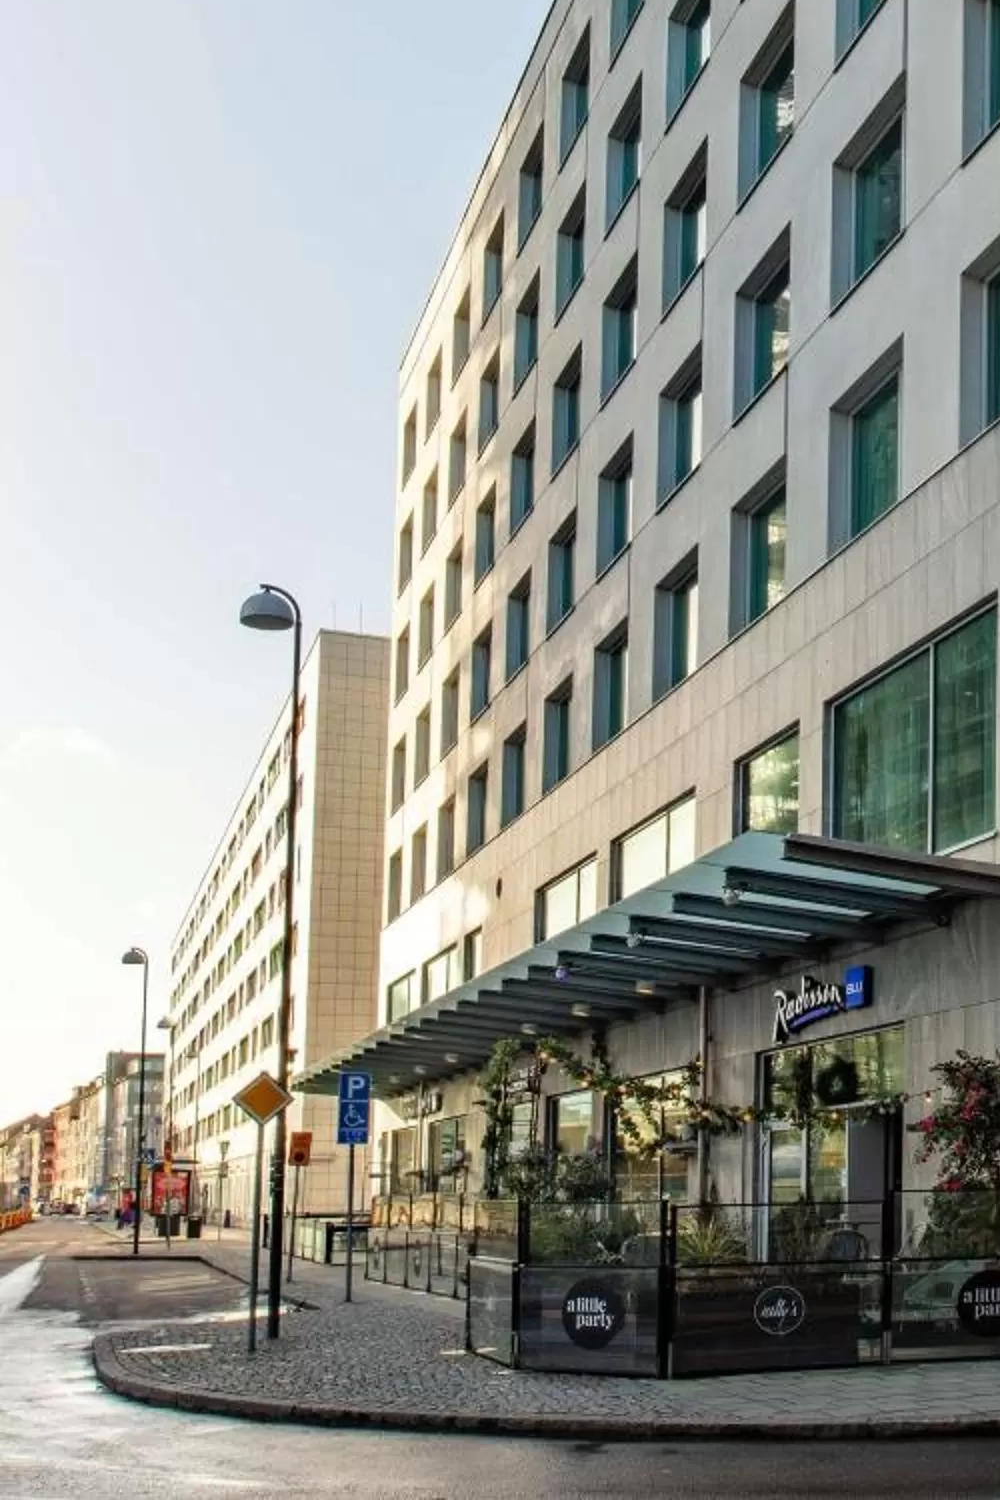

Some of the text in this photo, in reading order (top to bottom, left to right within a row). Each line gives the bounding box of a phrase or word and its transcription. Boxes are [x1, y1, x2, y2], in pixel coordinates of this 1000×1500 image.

[771, 974, 842, 1046] Radisson
[347, 1075, 366, 1099] P
[567, 1296, 607, 1313] a little
[963, 1291, 973, 1304] a
[575, 1313, 614, 1331] party
